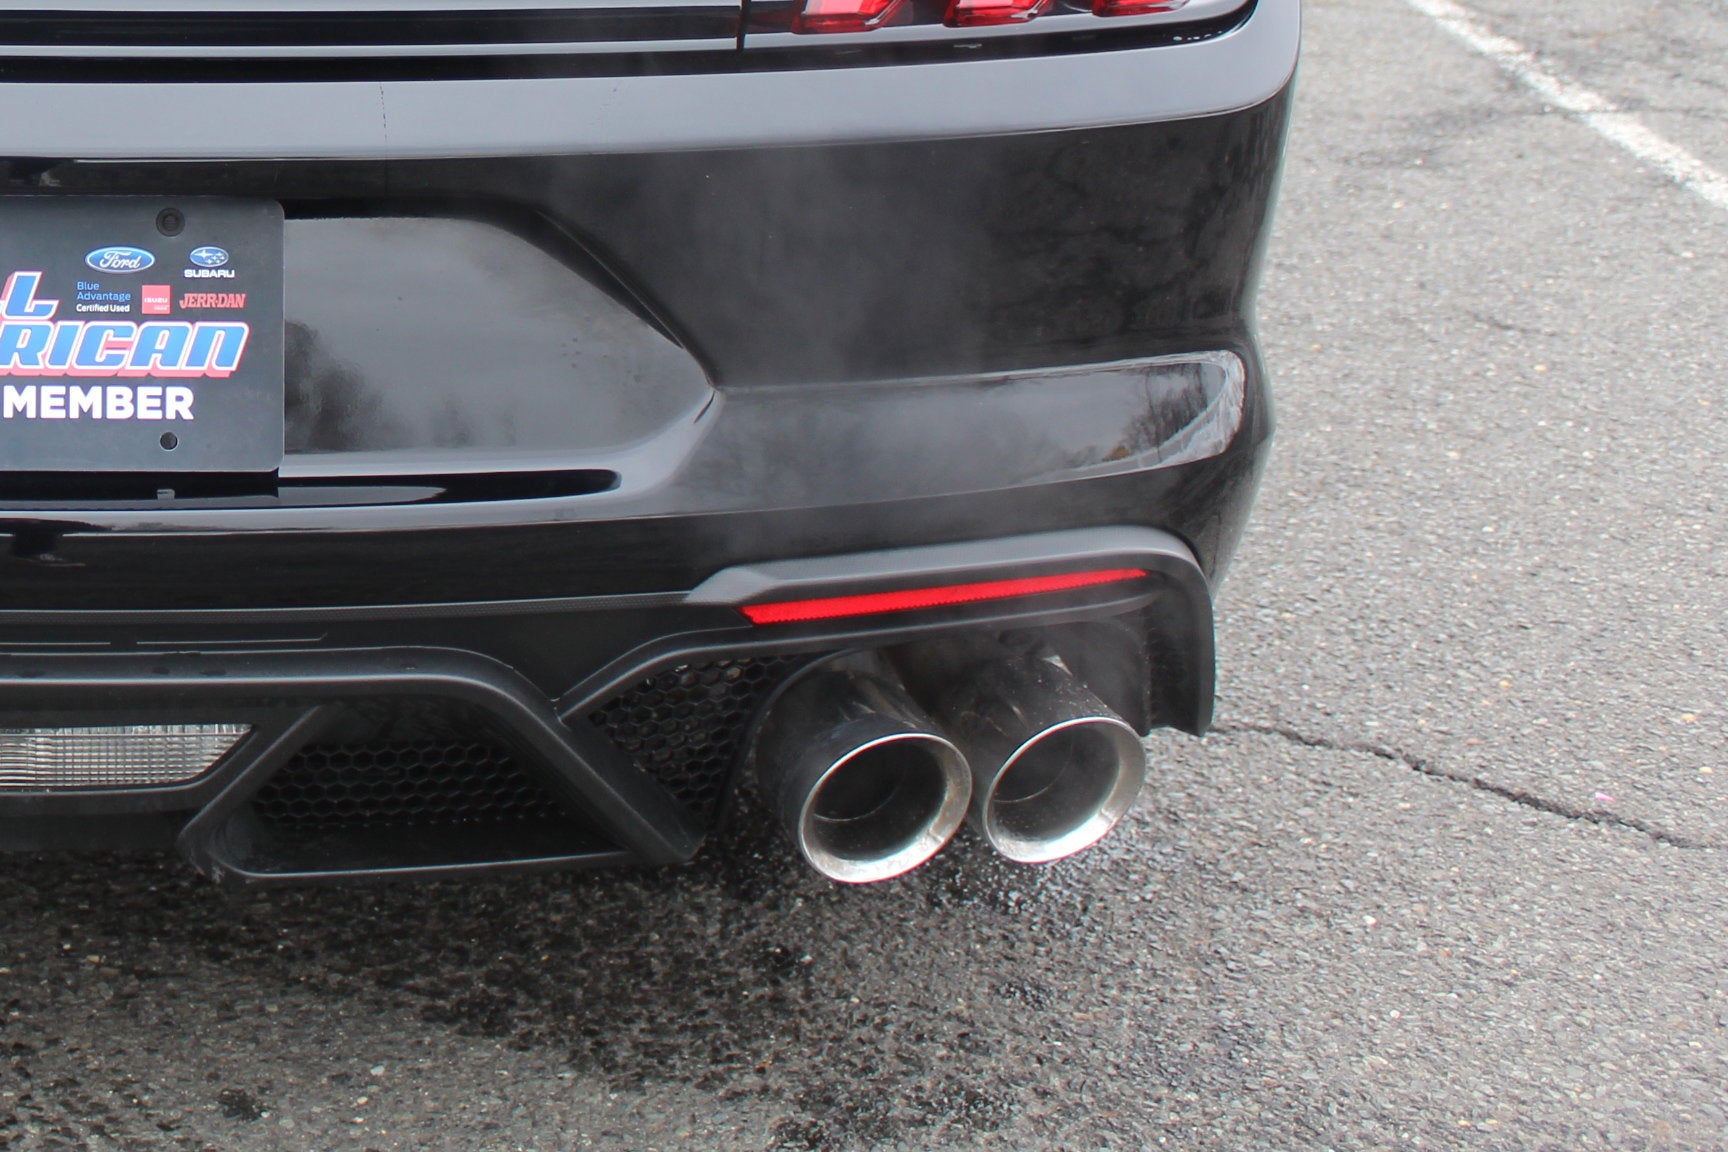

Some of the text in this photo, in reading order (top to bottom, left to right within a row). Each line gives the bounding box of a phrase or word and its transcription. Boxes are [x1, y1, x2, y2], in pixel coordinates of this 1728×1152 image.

[99, 249, 141, 269] Ford
[183, 269, 235, 278] SUBARU
[76, 281, 100, 290] Blue
[76, 291, 131, 302] Advantage
[76, 304, 130, 313] Certified Used
[3, 385, 194, 420] MEMBER
